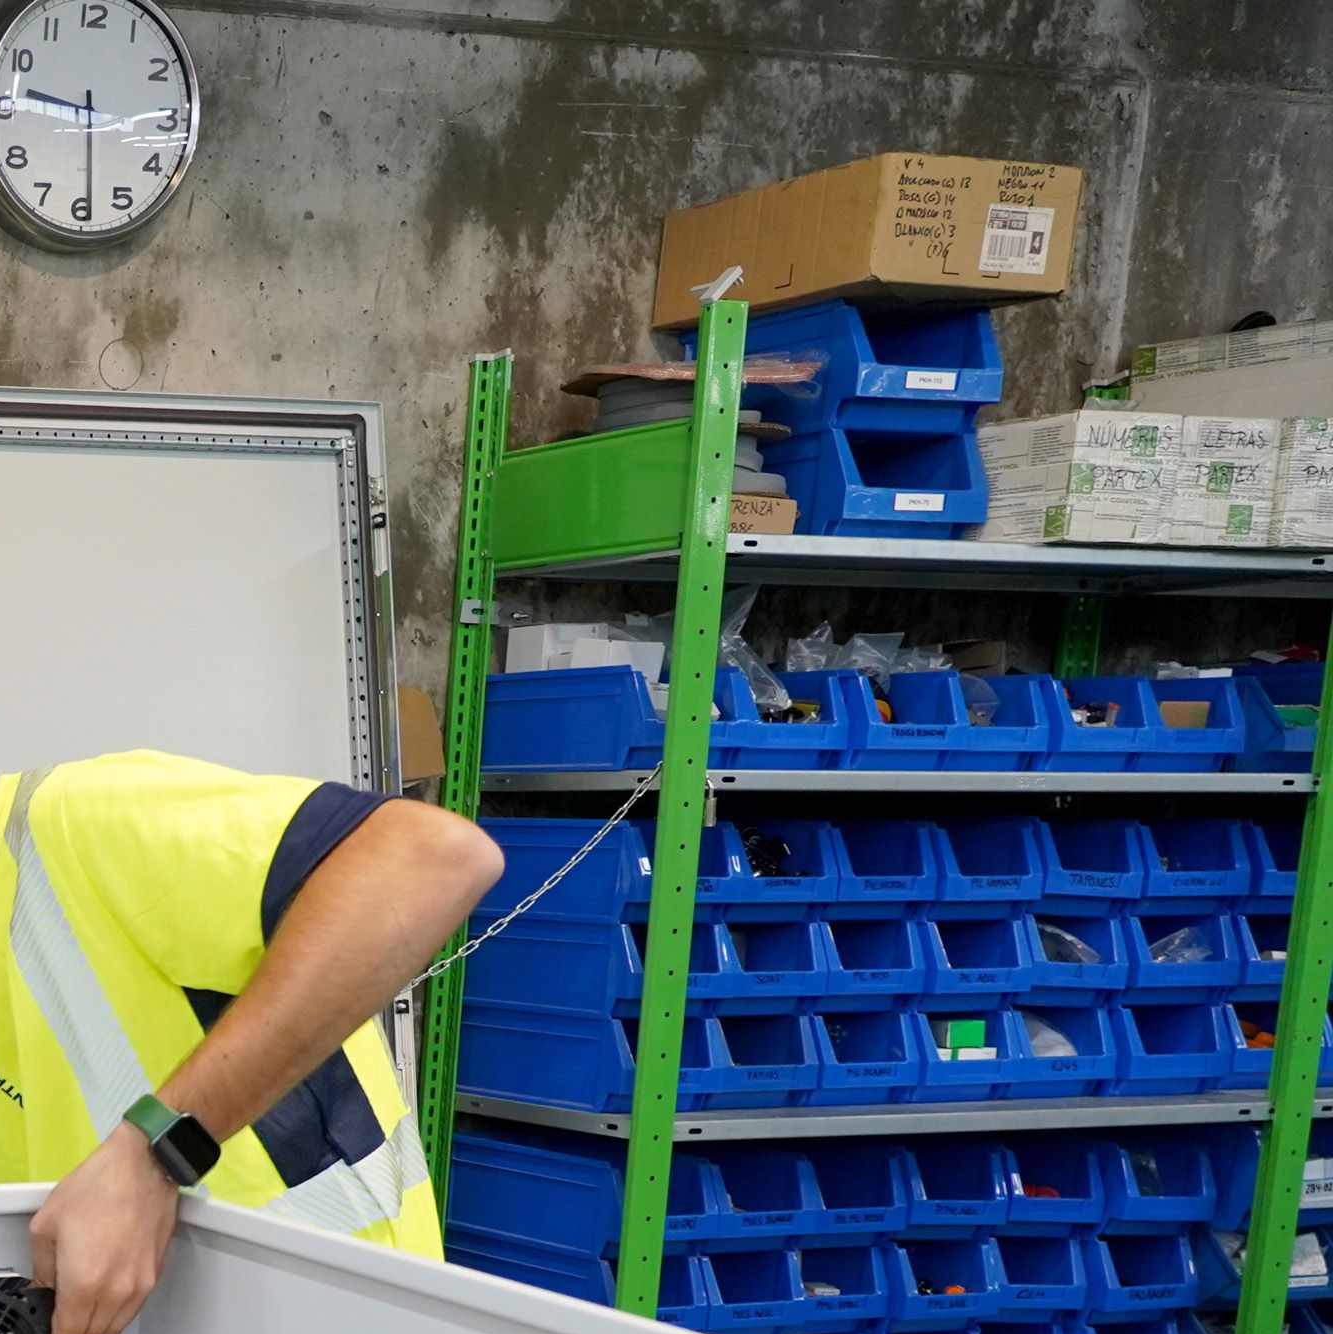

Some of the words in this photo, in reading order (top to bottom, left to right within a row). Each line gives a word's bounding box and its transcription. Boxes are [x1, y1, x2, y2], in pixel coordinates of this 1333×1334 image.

[81, 4, 108, 29] 12
[44, 17, 59, 41] 11
[130, 19, 136, 43] 1
[11, 49, 33, 72] 10
[148, 58, 169, 82] 2
[156, 107, 179, 132] 3
[5, 145, 29, 169] 8
[142, 152, 162, 176] 4
[34, 182, 52, 207] 7
[111, 186, 134, 210] 5
[71, 197, 92, 222] 6
[1204, 429, 1266, 448] LETRAS
[1092, 465, 1163, 490] PARTEX
[1195, 462, 1260, 485] PARTEX
